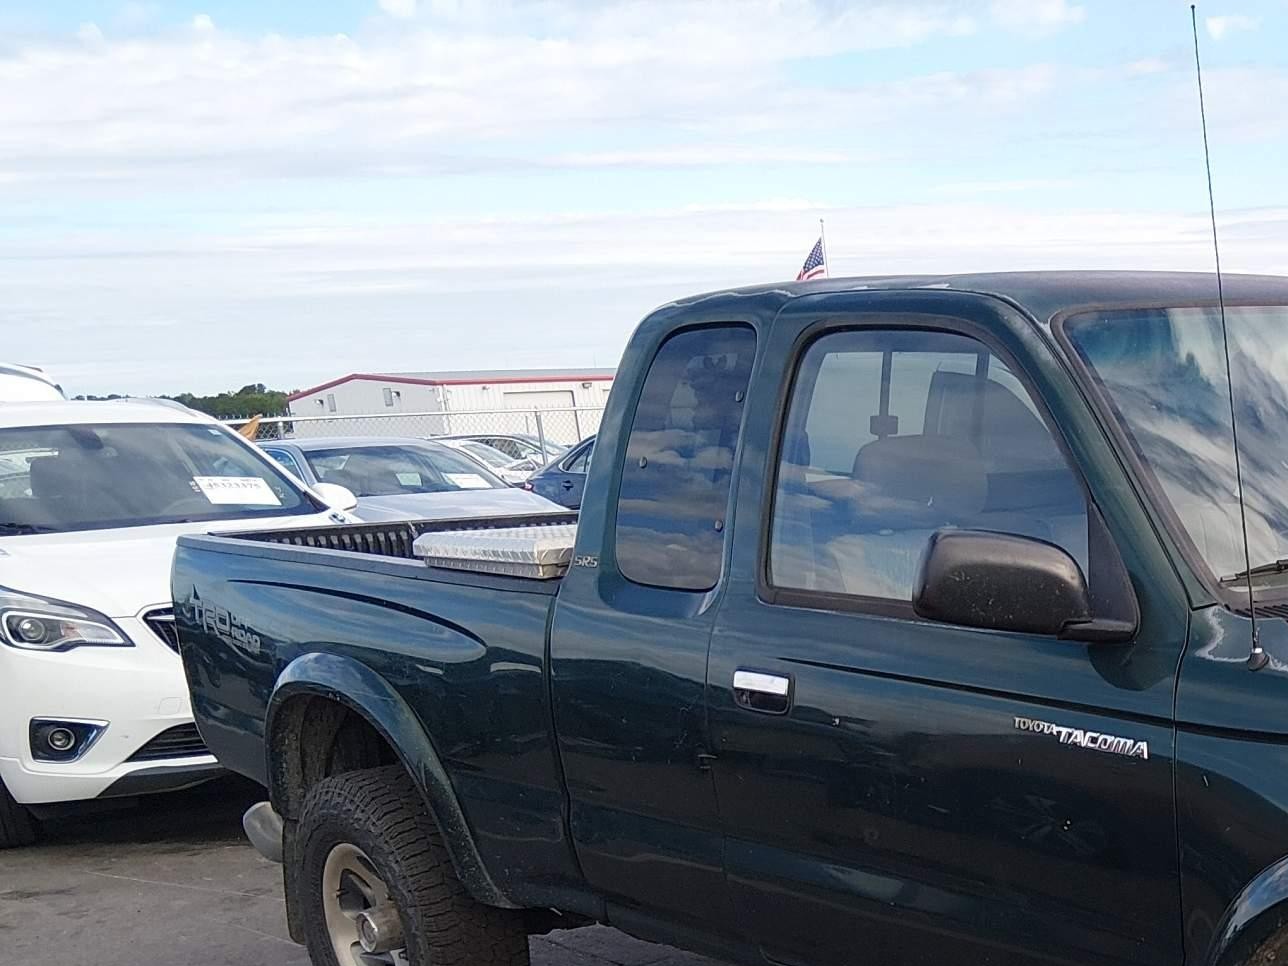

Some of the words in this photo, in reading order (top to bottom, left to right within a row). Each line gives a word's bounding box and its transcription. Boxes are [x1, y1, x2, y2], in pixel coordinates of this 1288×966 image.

[190, 597, 232, 638] TRD
[1014, 717, 1056, 735] TOYOTA
[1055, 727, 1149, 760] TACOMA
